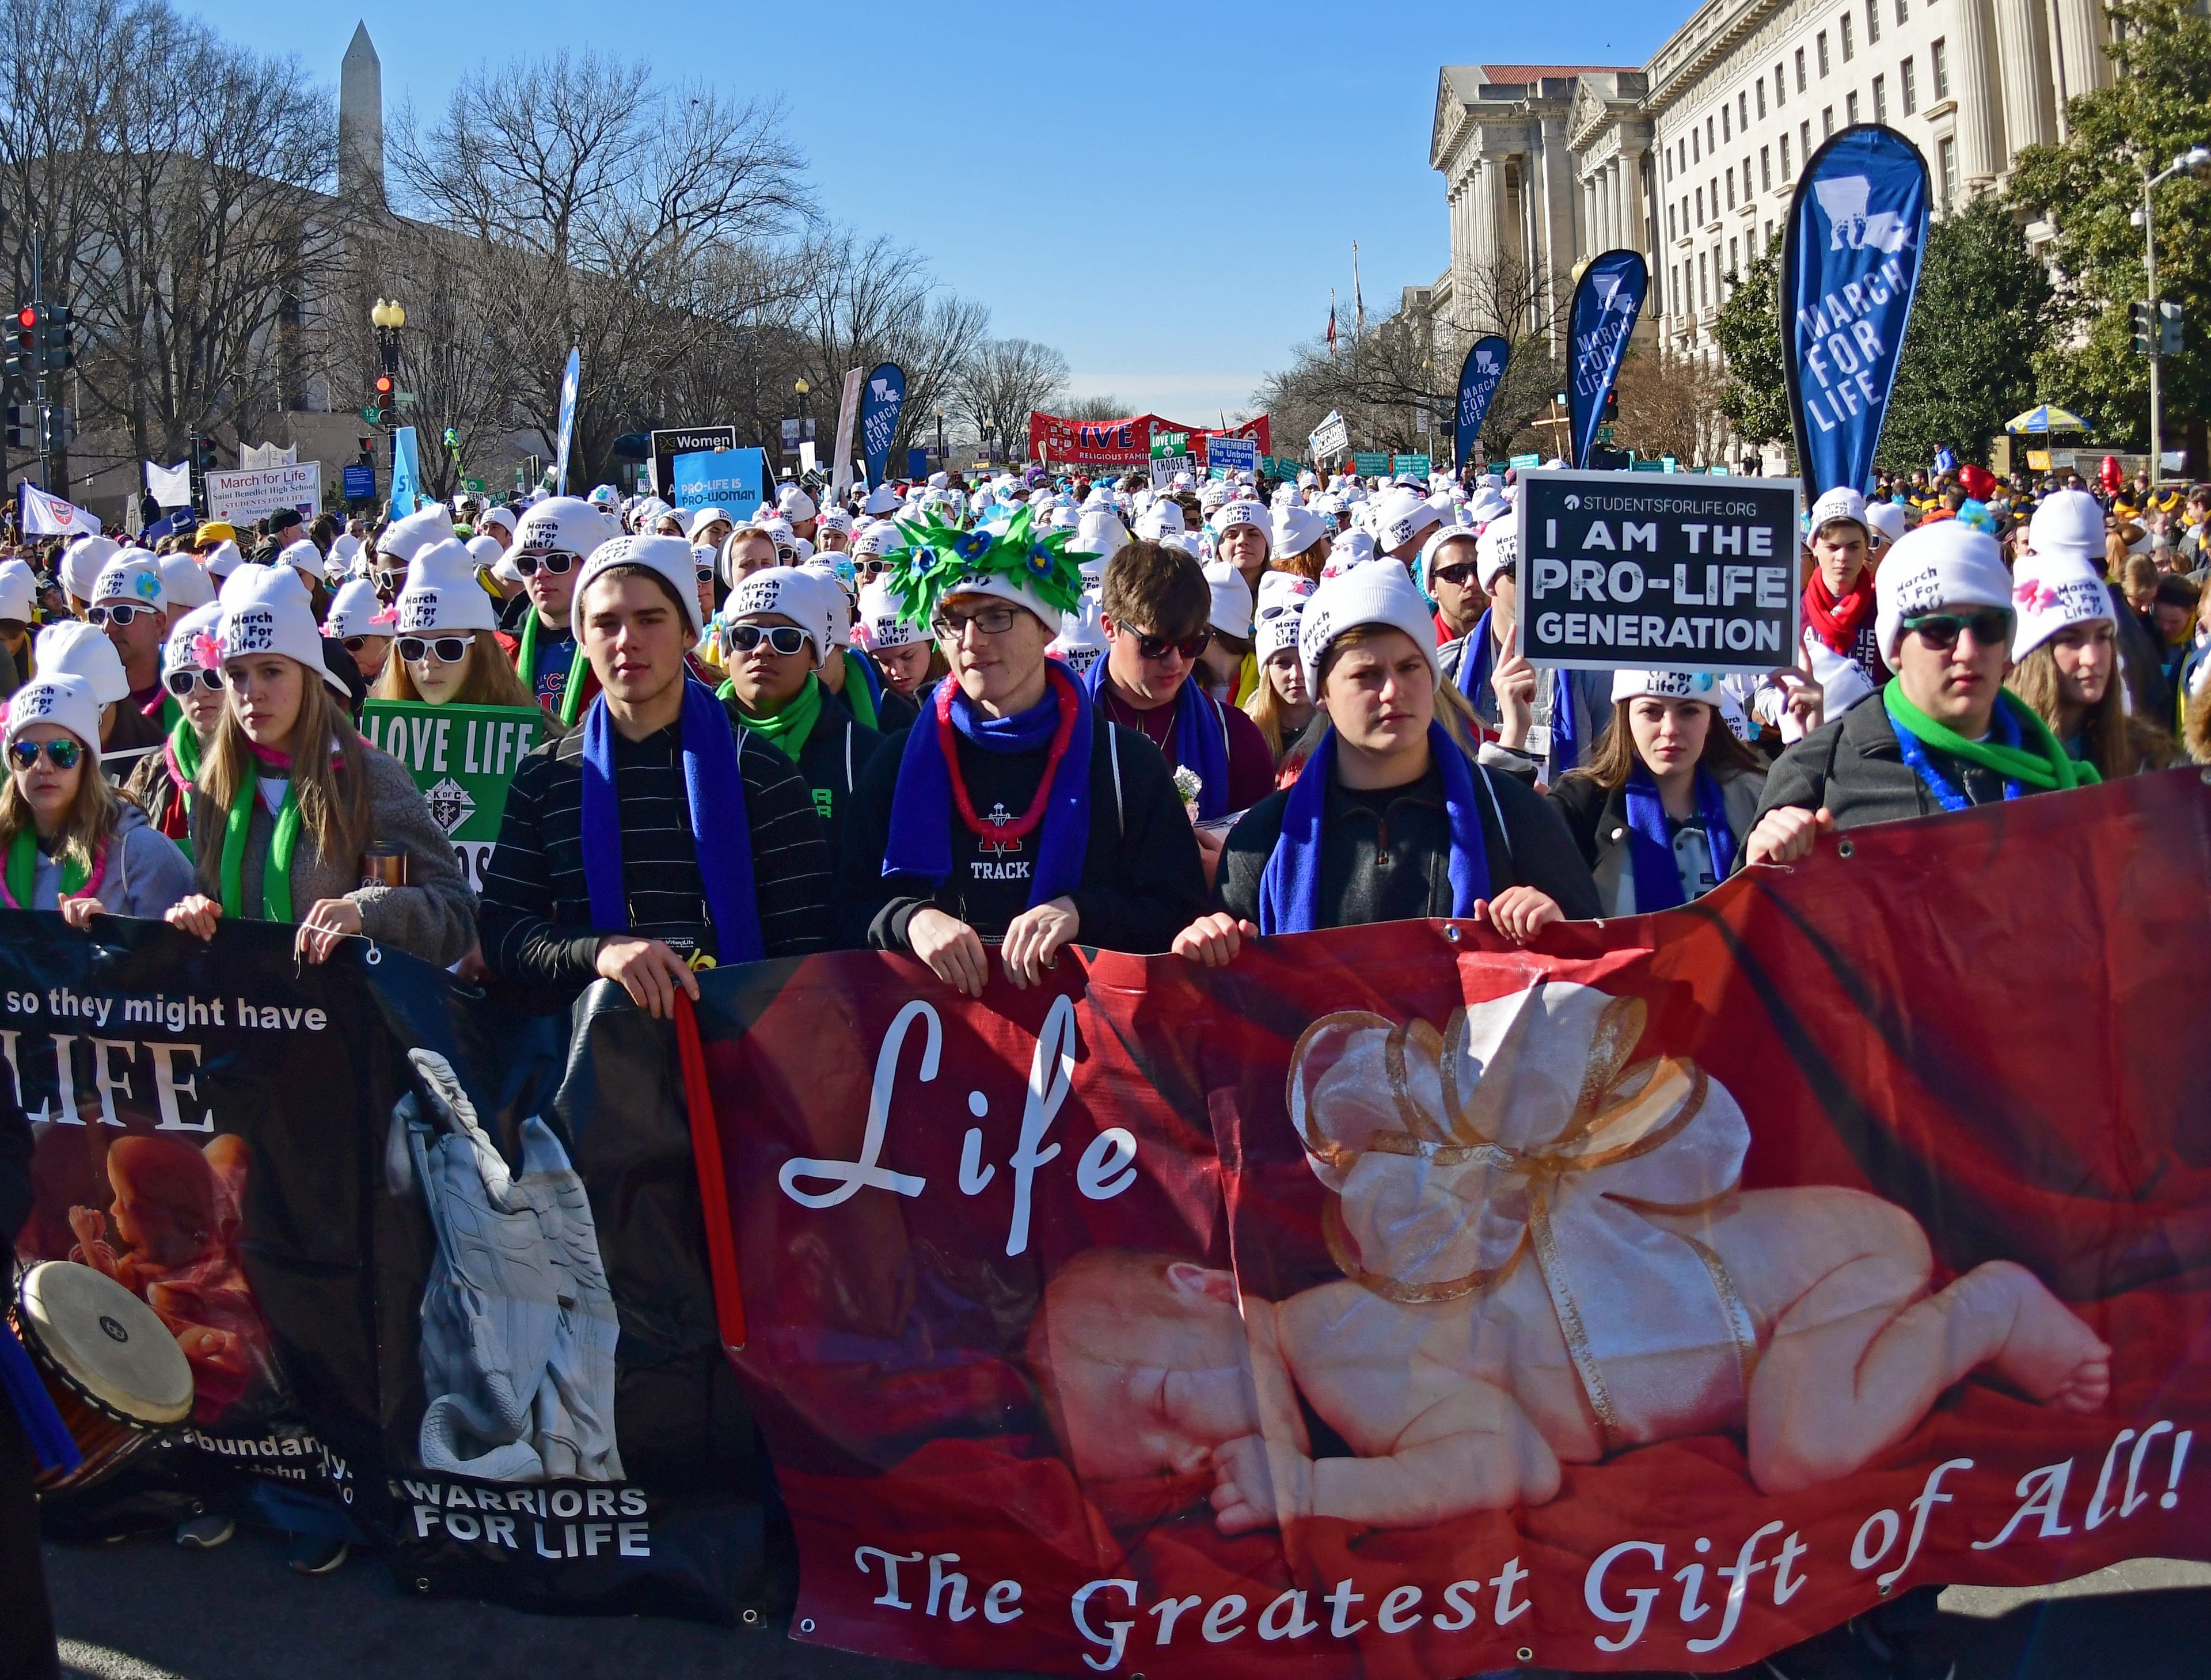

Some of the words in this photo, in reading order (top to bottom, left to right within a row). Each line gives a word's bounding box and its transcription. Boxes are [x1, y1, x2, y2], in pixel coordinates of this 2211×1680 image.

[1797, 259, 1908, 342] MARCH
[1576, 318, 1630, 353] MARCH
[1578, 345, 1616, 376] FOR
[1804, 320, 1886, 389] FOR
[1463, 377, 1496, 400] MARCH
[1576, 371, 1612, 397] LIFE
[1462, 394, 1485, 413] FOR
[1807, 369, 1882, 432] LIFE
[865, 404, 898, 429] MARCH
[1460, 409, 1482, 427] LIFE
[866, 422, 891, 443] FOR
[1080, 421, 1135, 449] IVE
[1316, 423, 1343, 444] DEFUND
[1597, 428, 1605, 436] 12
[677, 436, 730, 448] Women
[867, 436, 889, 455] LIFE
[1152, 435, 1168, 447] LOVE
[1171, 433, 1184, 445] LIFE
[1210, 439, 1252, 451] REMEMBER
[1317, 432, 1345, 450] PLANNED
[1079, 452, 1122, 460] RELIGIOUS
[1210, 448, 1224, 457] The
[1226, 449, 1252, 459] Unborn
[1157, 457, 1184, 472] CHOOSE
[221, 474, 259, 489] March
[263, 473, 280, 484] for
[283, 470, 306, 482] Life
[682, 478, 729, 495] PRO-LIFE
[732, 478, 742, 489] IS
[235, 489, 267, 499] Benedict
[269, 486, 288, 495] High
[290, 483, 316, 491] School
[682, 489, 755, 507] PRO-WOMAN
[225, 500, 266, 508] STUDENTS
[1584, 496, 1757, 517] STUDENTSFORLIFE.ORG
[527, 521, 559, 531] March
[1390, 519, 1410, 534] March
[1401, 525, 1412, 534] For
[538, 531, 557, 539] For
[1396, 534, 1410, 544] Life
[1496, 535, 1517, 546] Marc
[1545, 518, 1556, 549] I
[1582, 520, 1657, 552] AM
[1681, 523, 1772, 557] THE
[524, 540, 542, 549] Life
[742, 580, 780, 592] March
[1532, 558, 1787, 609] PRO-LIFE
[1897, 567, 1938, 592] March
[97, 588, 111, 597] Life
[756, 590, 778, 598] For
[1916, 581, 1940, 598] For
[2058, 580, 2098, 595] March
[406, 594, 437, 605] March
[739, 601, 761, 613] Life
[2082, 595, 2100, 604] For
[417, 606, 436, 615] For
[2065, 605, 2092, 619] Life
[231, 612, 273, 627] March
[403, 615, 421, 628] Life
[1275, 621, 1300, 629] Marc
[249, 626, 273, 637] For
[1314, 624, 1330, 646] For
[1536, 611, 1781, 652] GENERATION
[231, 639, 256, 653] Life
[879, 637, 899, 645] Life
[1275, 637, 1296, 646] Life
[172, 656, 189, 667] Life
[1069, 649, 1100, 659] March
[20, 686, 55, 701] March
[1647, 679, 1674, 693] Life
[32, 697, 54, 705] For
[17, 708, 36, 721] Life
[465, 720, 534, 775] LIFE
[434, 790, 440, 799] K
[454, 791, 461, 800] C
[971, 862, 1030, 879] TRACK
[6, 990, 39, 1013] so
[48, 987, 113, 1028] they
[124, 994, 225, 1032] might
[238, 997, 328, 1030] have
[0, 1028, 215, 1133] LIFE
[778, 994, 1138, 1257] Life
[404, 1480, 648, 1518] WARRIORS
[413, 1504, 519, 1550] FOR
[534, 1522, 651, 1559] LIFE
[854, 1544, 1024, 1625] The
[1070, 1554, 1533, 1673] Greatest
[1584, 1520, 1808, 1652] Gift
[1850, 1457, 1974, 1587] of
[1971, 1419, 2193, 1552] All!
